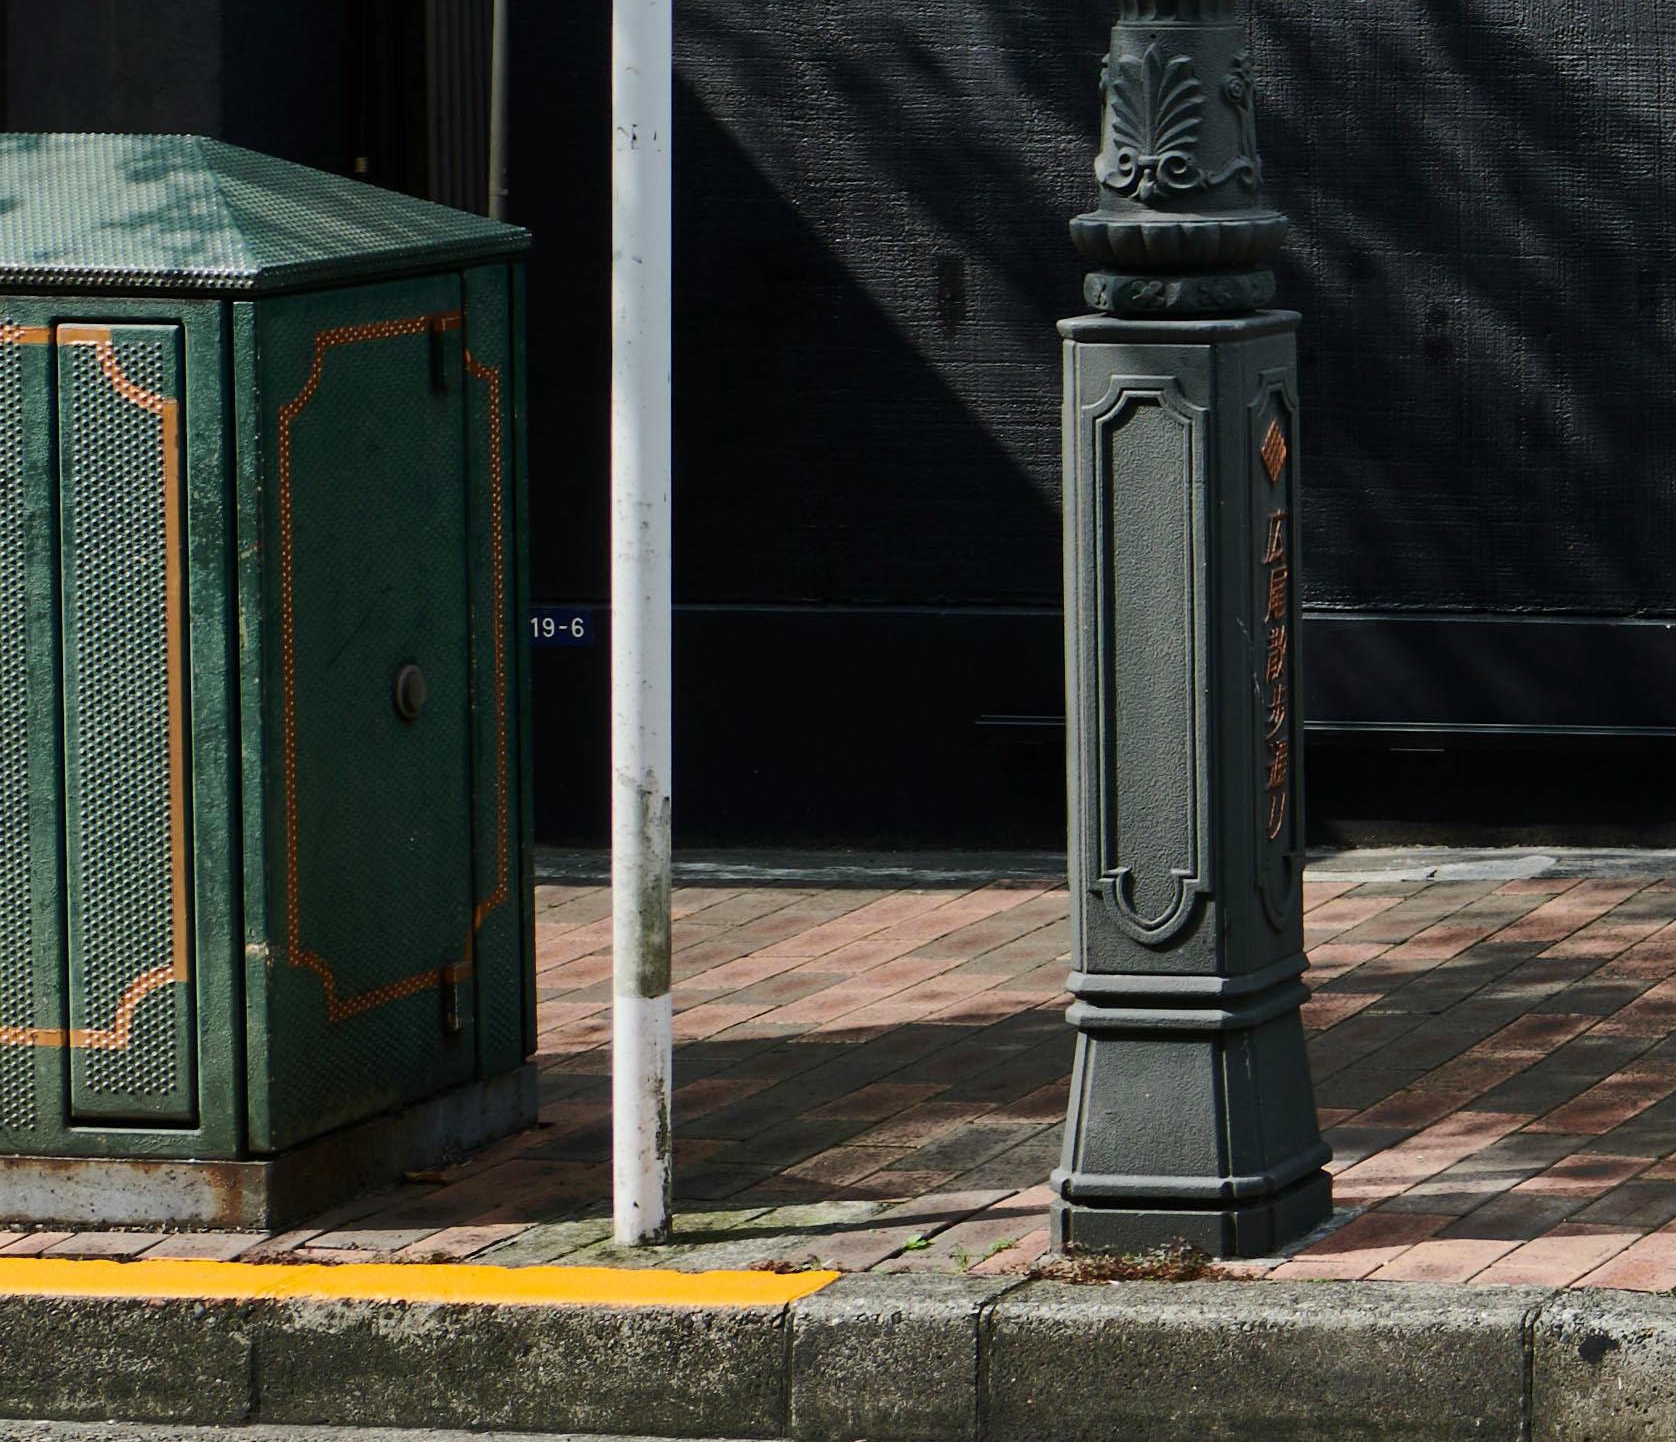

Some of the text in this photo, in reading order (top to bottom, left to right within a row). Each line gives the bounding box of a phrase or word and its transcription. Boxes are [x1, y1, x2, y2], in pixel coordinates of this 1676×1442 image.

[530, 617, 584, 638] 19-6
[1264, 509, 1288, 839] 広尾散歩通り
